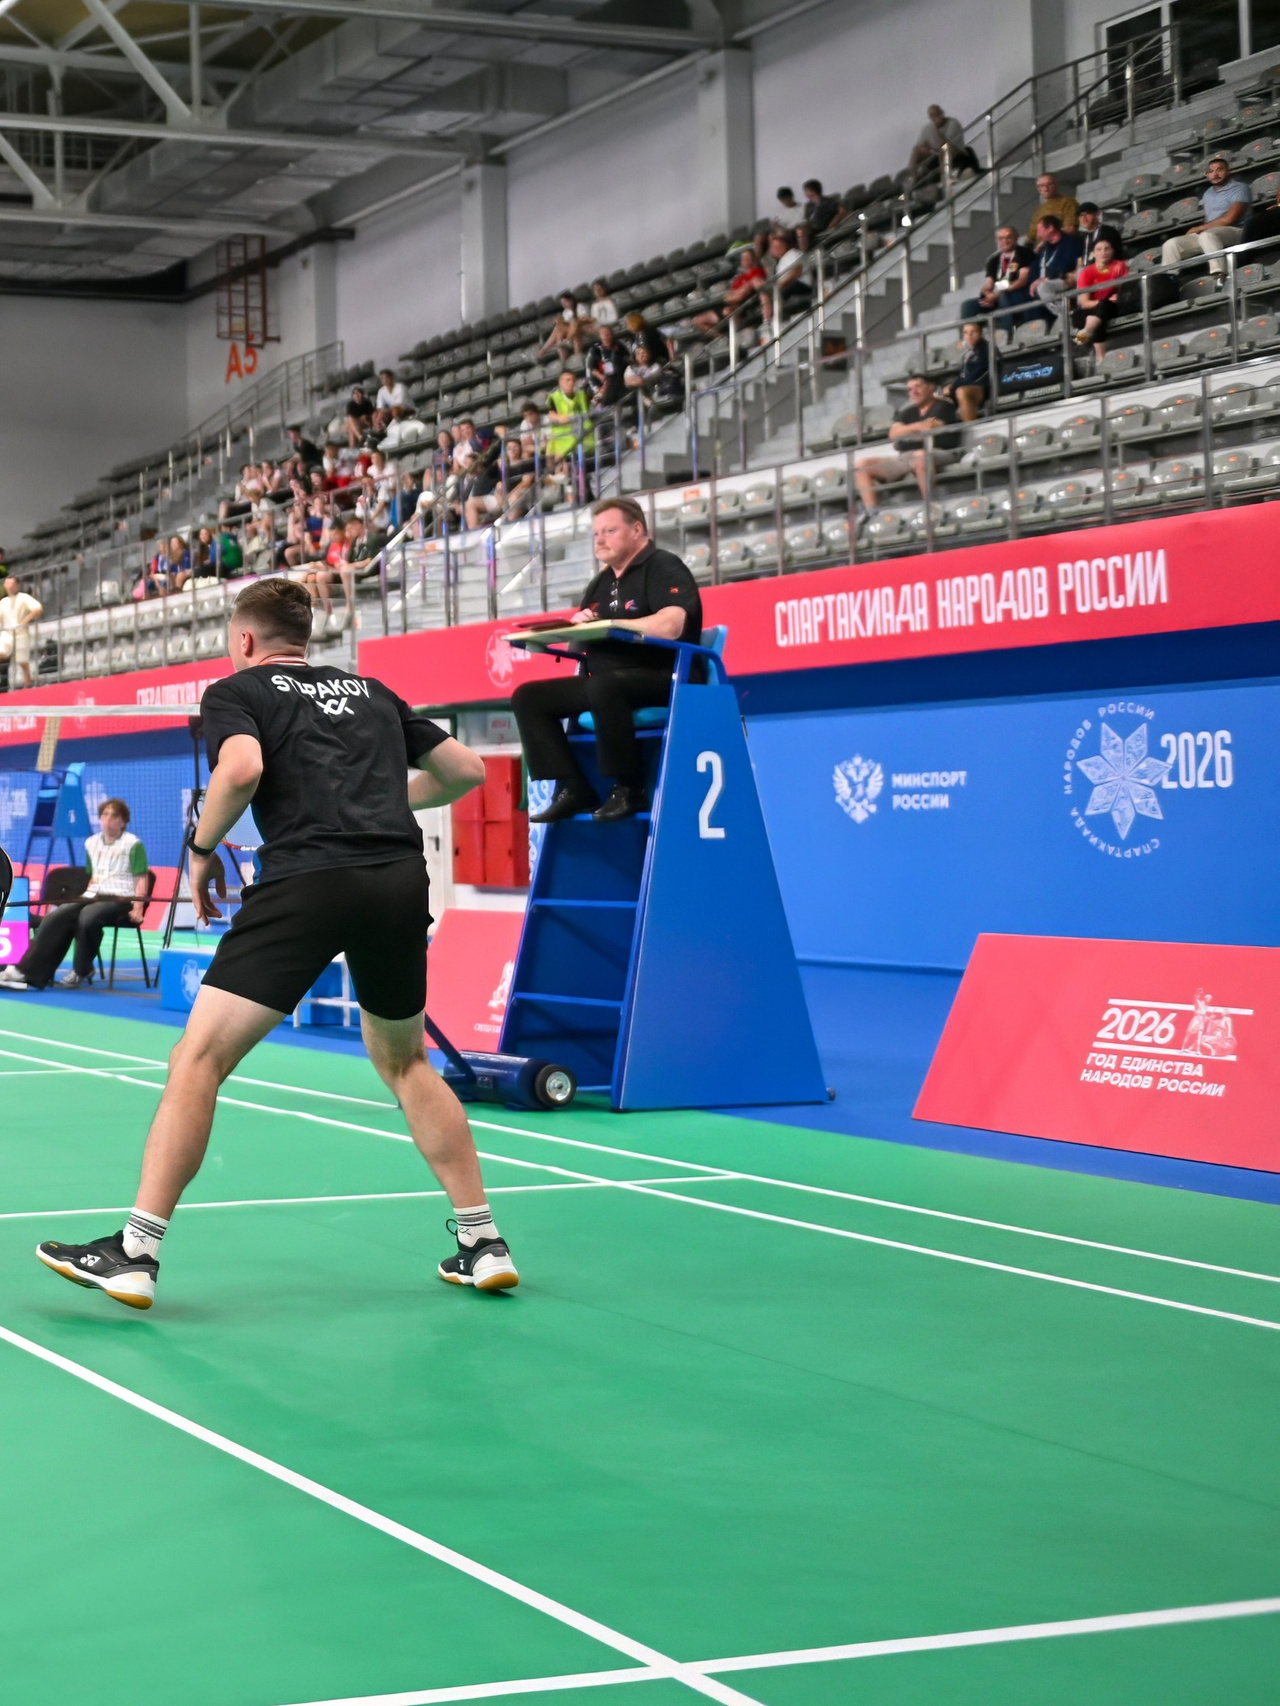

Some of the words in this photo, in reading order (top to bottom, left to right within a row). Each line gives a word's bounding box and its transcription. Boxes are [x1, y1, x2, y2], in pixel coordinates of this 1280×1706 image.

[775, 582, 929, 648] СПАРТАКИАДА
[937, 566, 1049, 629] НАРОДОВ
[1058, 549, 1168, 615] РОССИИ
[1160, 729, 1233, 789] 2026
[696, 750, 726, 839] 2
[891, 771, 967, 789] МИНСПОРТ
[892, 793, 949, 810] РОССИИ
[1096, 1007, 1177, 1045] 2026
[1086, 1053, 1117, 1069] ГОД
[1120, 1056, 1204, 1077] ЕДИНСТВА
[1080, 1069, 1153, 1088] НАРОДОВ
[1157, 1077, 1226, 1097] РОССИИ
